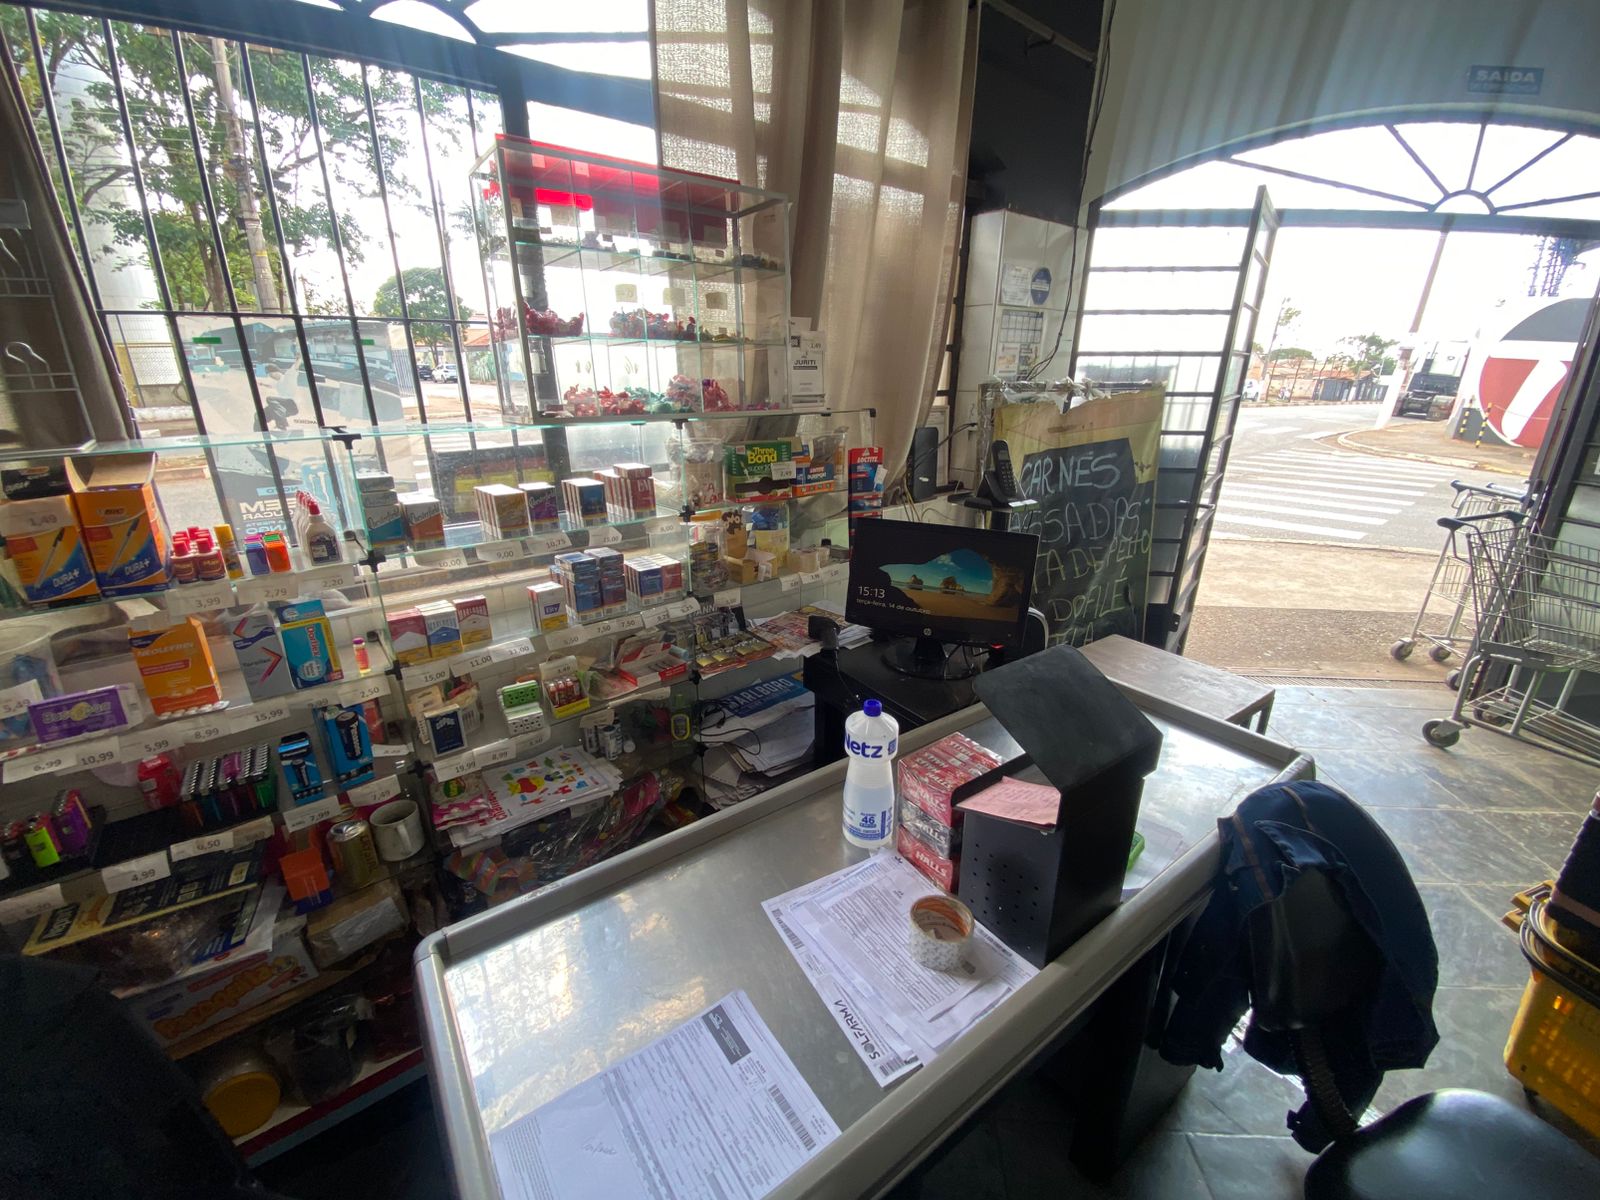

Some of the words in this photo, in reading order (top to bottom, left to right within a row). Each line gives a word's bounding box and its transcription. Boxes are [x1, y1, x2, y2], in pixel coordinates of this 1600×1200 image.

[748, 451, 777, 464] Bond
[753, 446, 775, 456] Three
[263, 586, 288, 600] 2,79
[857, 586, 886, 599] 15:13
[469, 654, 493, 668] 11,00
[358, 685, 381, 699] 2,50
[255, 709, 284, 722] 15,99
[194, 727, 220, 740] 8,99
[143, 739, 170, 753] 5,99
[80, 750, 115, 766] 10,99
[455, 761, 476, 773] 19,99
[309, 809, 330, 822] 7,99
[861, 815, 876, 825] 46
[915, 850, 948, 877] HALLS
[131, 868, 156, 883] 4,99
[834, 999, 881, 1060] SOLFARMA
